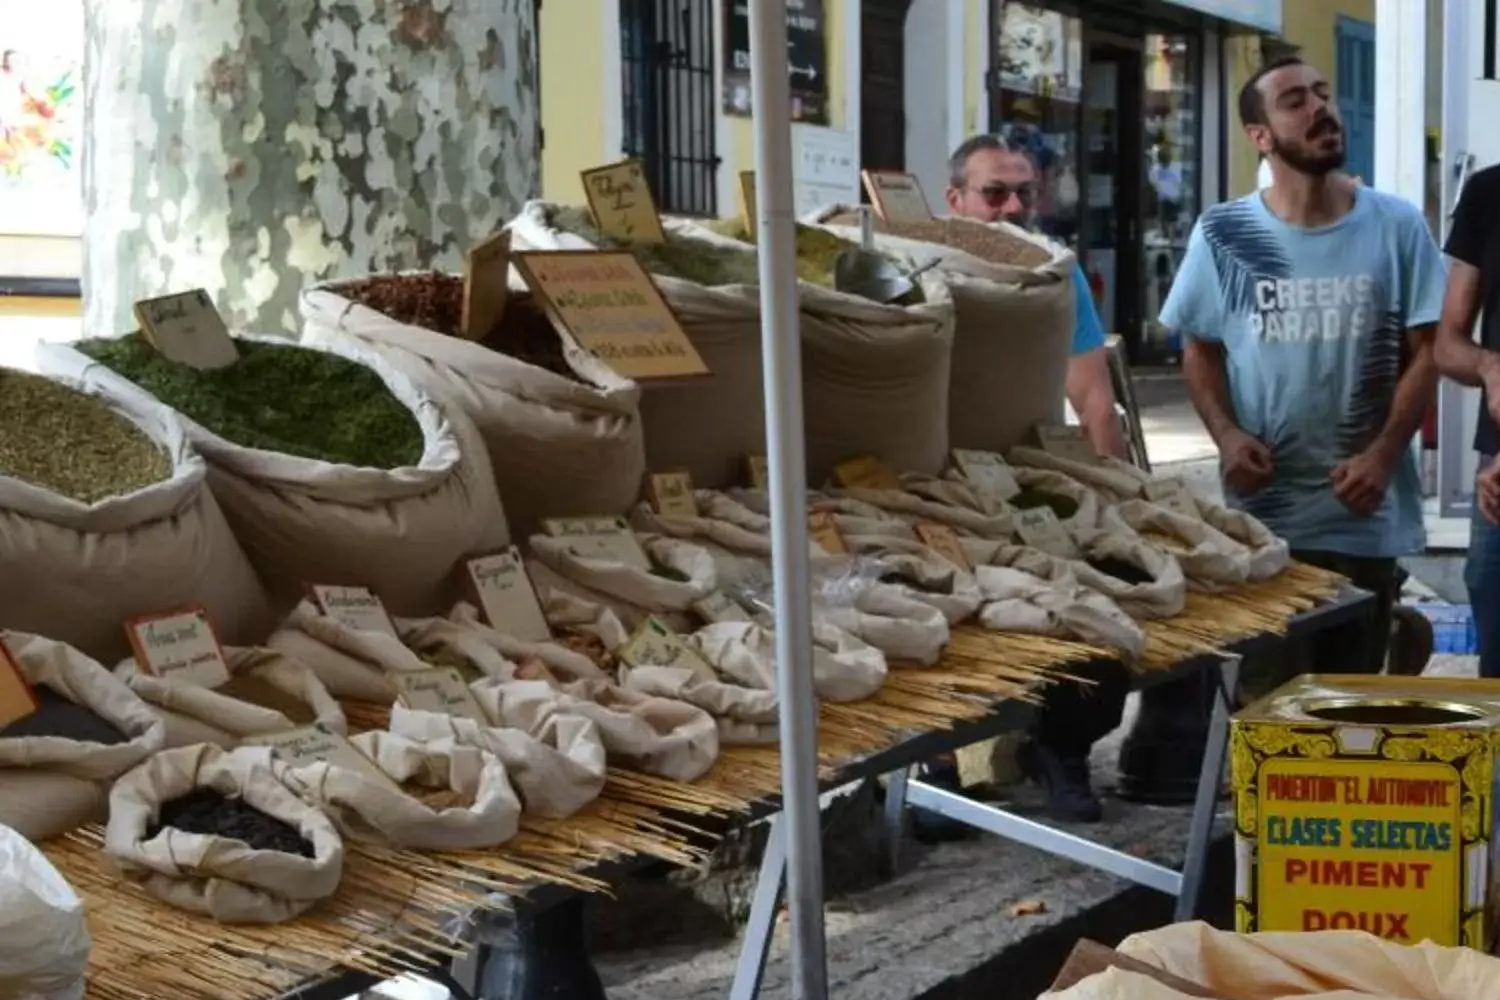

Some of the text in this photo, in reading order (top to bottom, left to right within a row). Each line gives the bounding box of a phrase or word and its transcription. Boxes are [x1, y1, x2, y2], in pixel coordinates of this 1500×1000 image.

[1255, 273, 1373, 311] CREEKS
[1266, 815, 1452, 851] CLASES SELECTAS
[1285, 858, 1432, 889] PIMENT
[1302, 908, 1410, 940] DOUX
